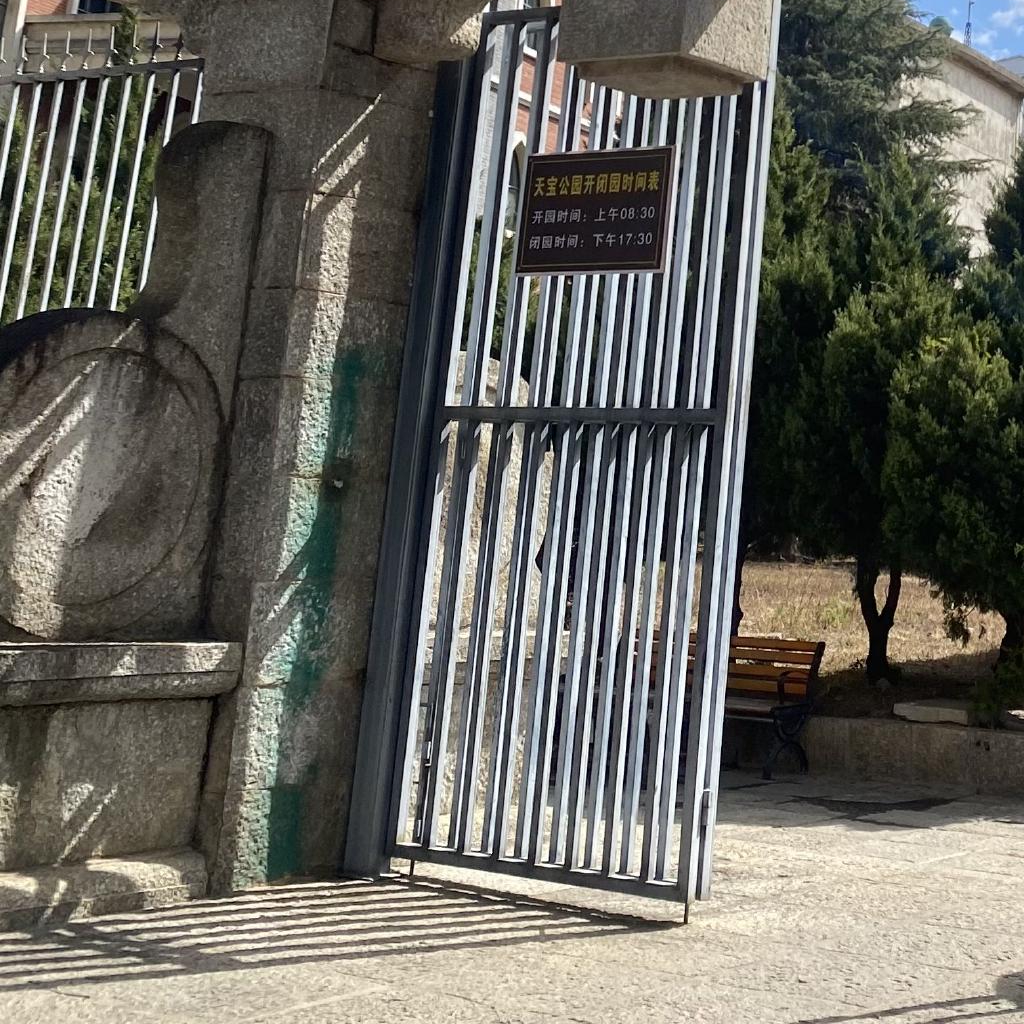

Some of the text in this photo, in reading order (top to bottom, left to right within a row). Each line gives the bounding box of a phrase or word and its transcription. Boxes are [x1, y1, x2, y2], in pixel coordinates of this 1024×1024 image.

[534, 171, 659, 196] 天宝公园开闭园时间表
[531, 206, 656, 225] 开园时间： 上午08:30
[529, 232, 653, 250] 闭园时间： 下午17:30
